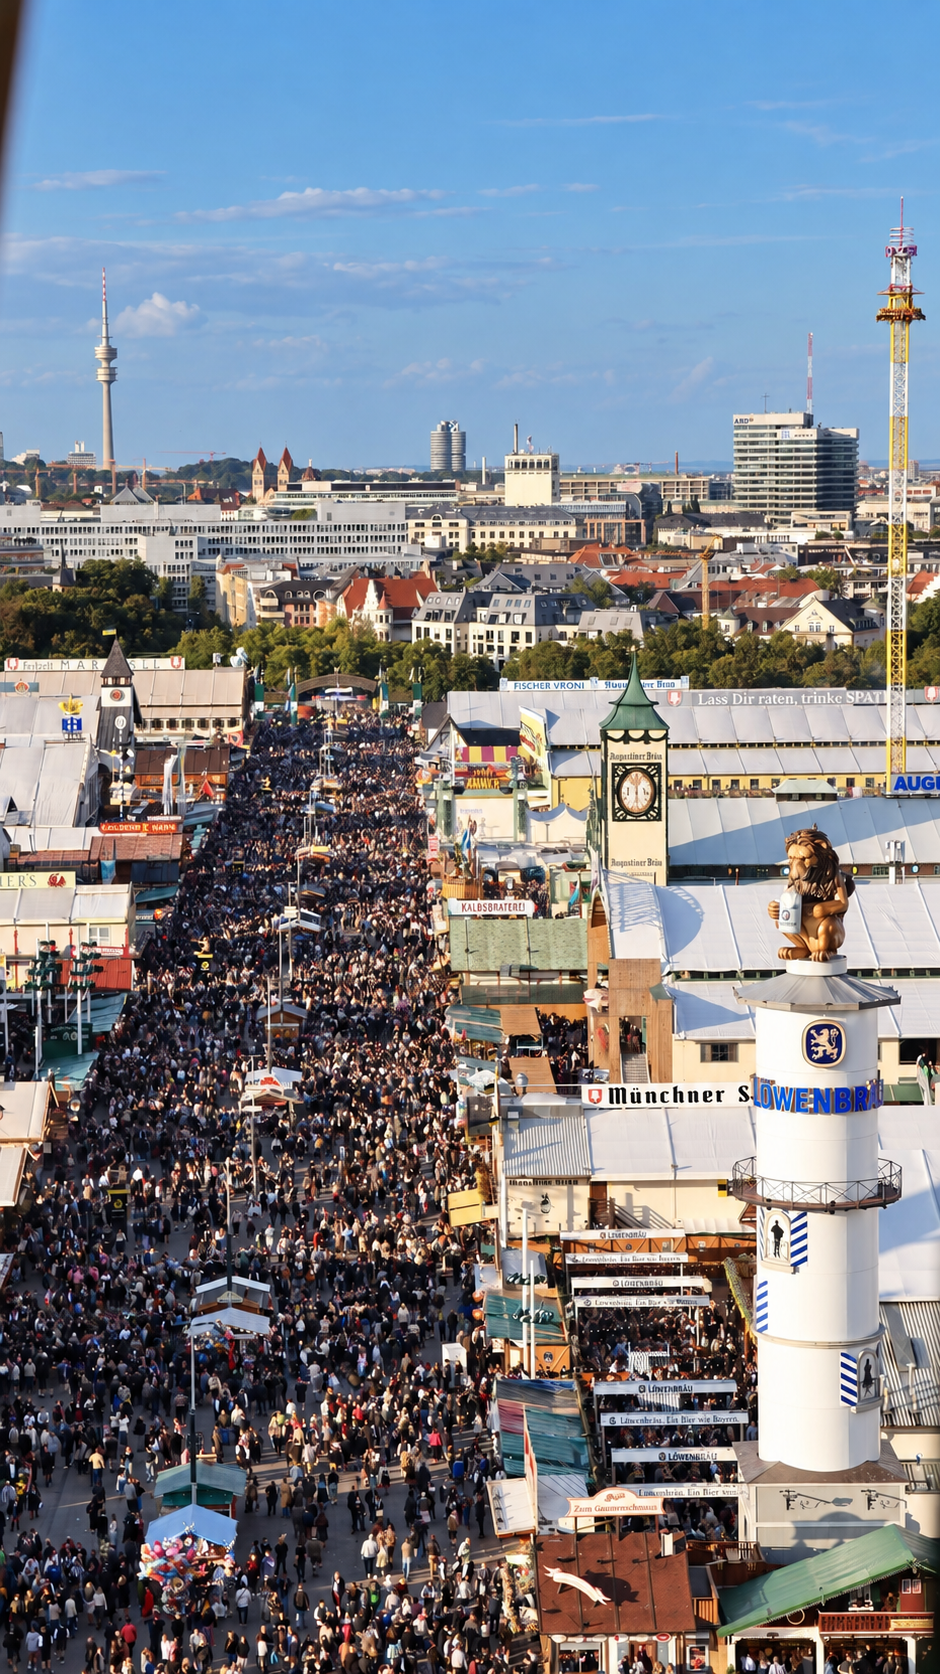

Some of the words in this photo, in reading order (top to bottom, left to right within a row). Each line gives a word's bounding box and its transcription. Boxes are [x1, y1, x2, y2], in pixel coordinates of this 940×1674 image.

[514, 682, 551, 690] FISCHER
[554, 682, 585, 690] VRONI
[698, 693, 728, 705] Lass
[732, 693, 754, 705] Dir
[758, 693, 798, 706] raten,
[801, 692, 842, 704] trinke
[608, 1085, 725, 1105] Münchner
